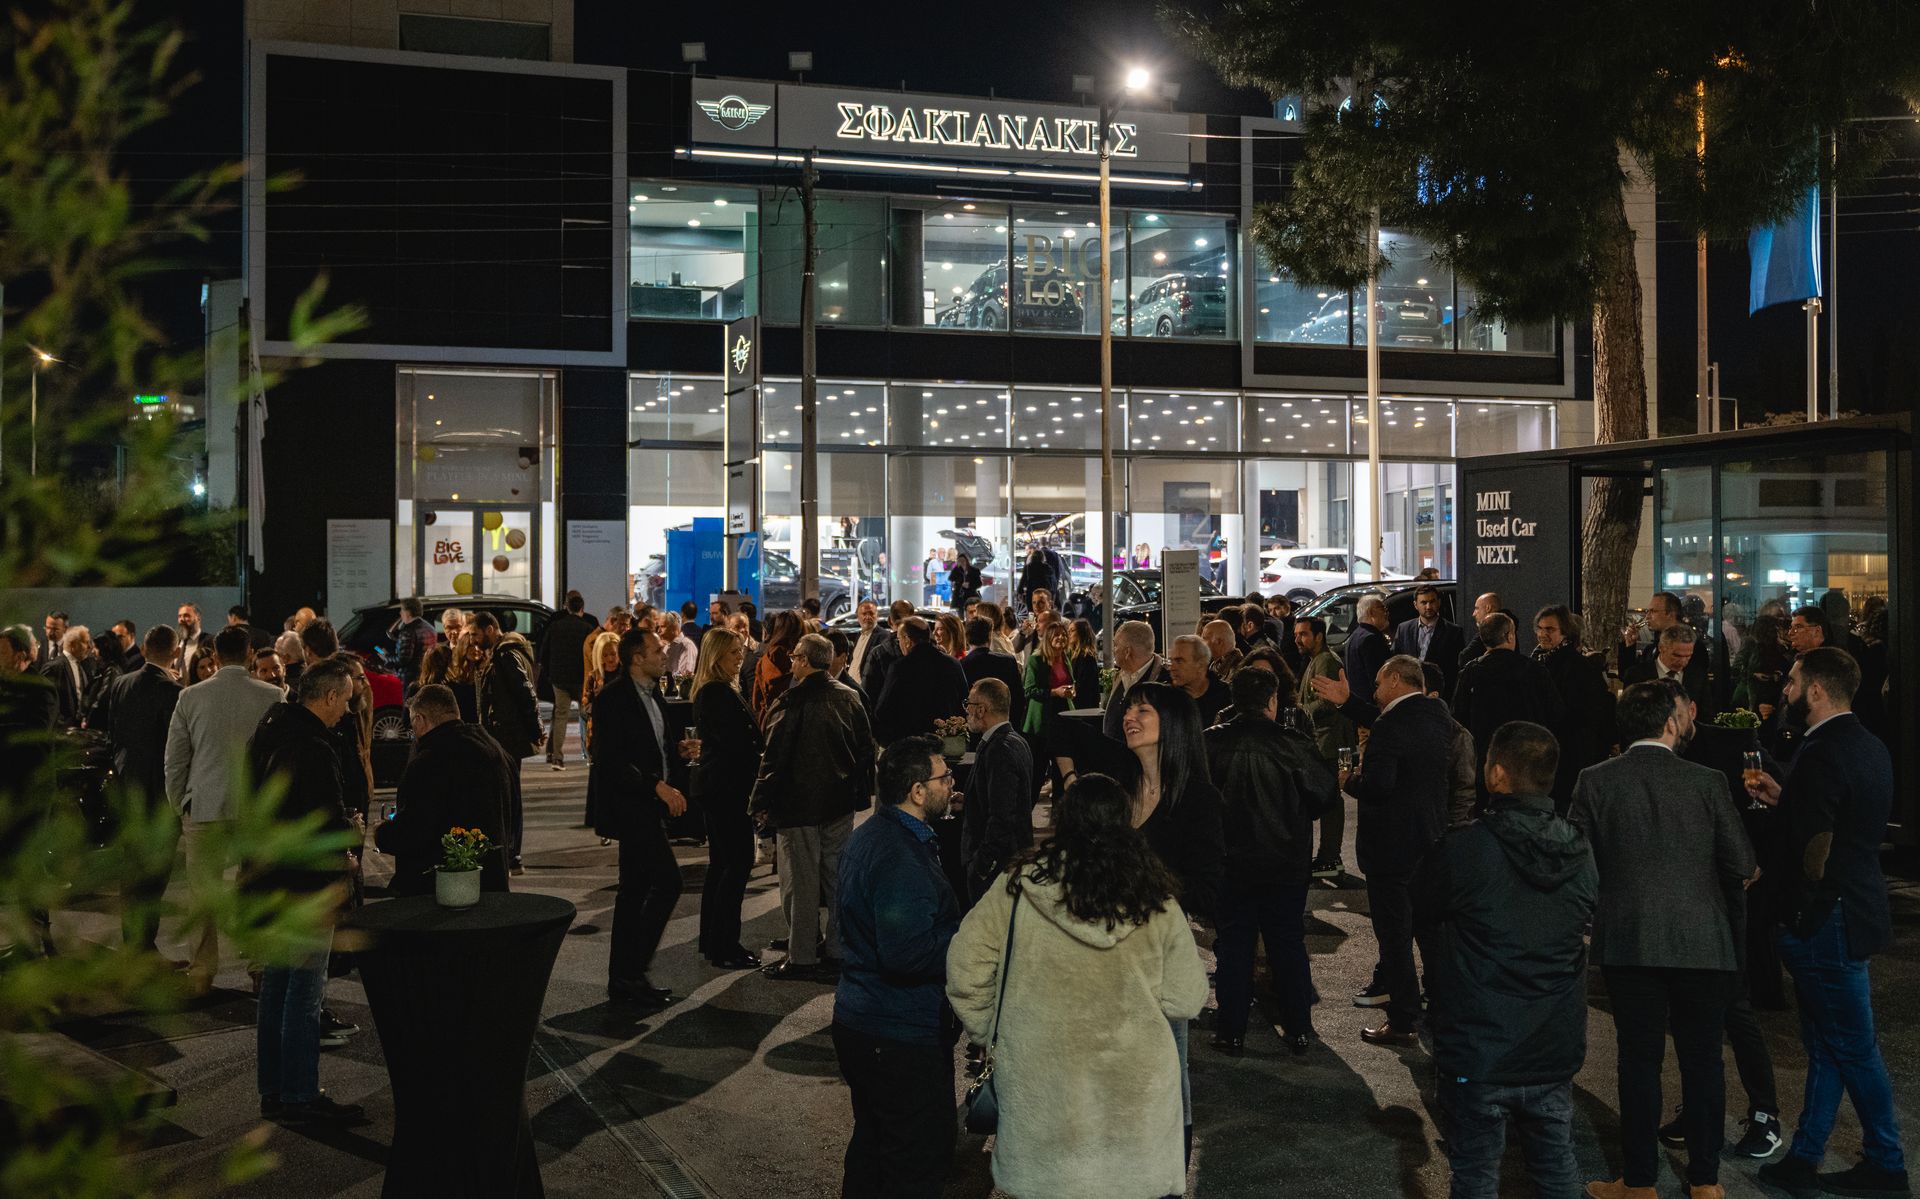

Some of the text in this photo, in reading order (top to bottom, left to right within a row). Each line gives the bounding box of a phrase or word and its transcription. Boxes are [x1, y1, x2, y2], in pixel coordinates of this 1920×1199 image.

[721, 107, 746, 119] MINI
[1476, 491, 1511, 511] MINI
[1476, 516, 1537, 538] Used Car
[433, 552, 465, 565] LOVE
[1476, 545, 1519, 564] NEXT.
